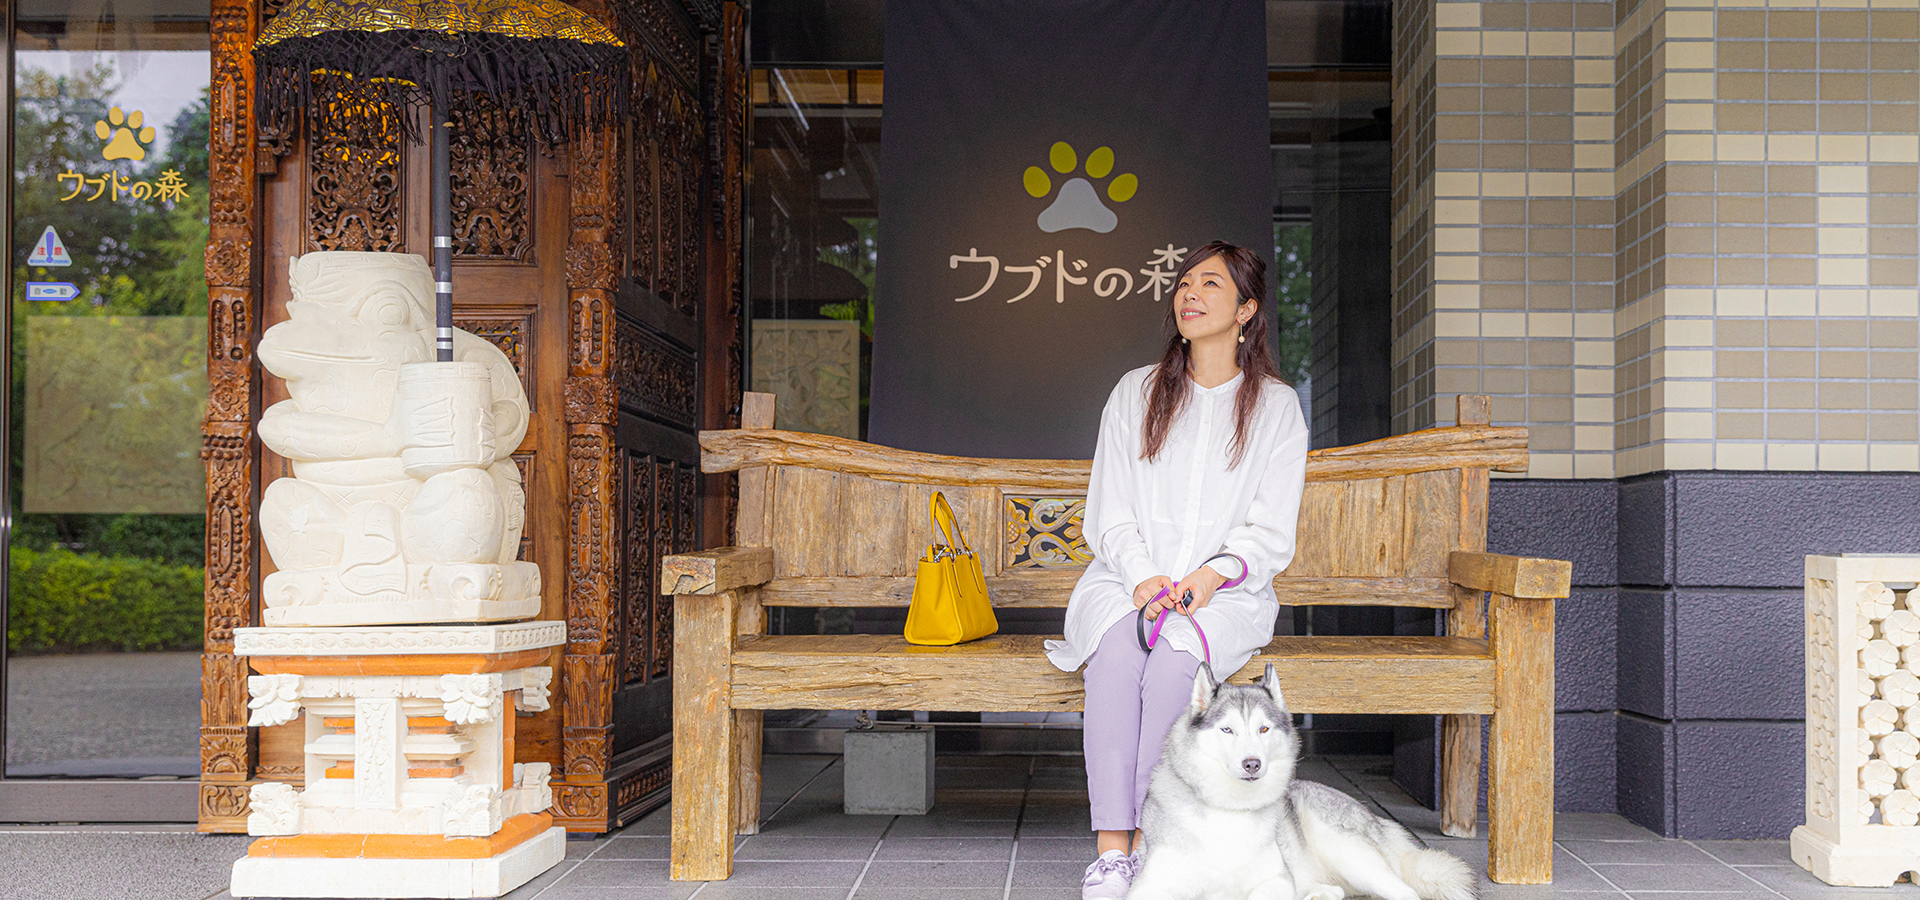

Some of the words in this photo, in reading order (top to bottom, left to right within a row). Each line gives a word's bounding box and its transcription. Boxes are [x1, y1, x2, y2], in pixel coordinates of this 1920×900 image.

[57, 168, 190, 202] ウブドの森
